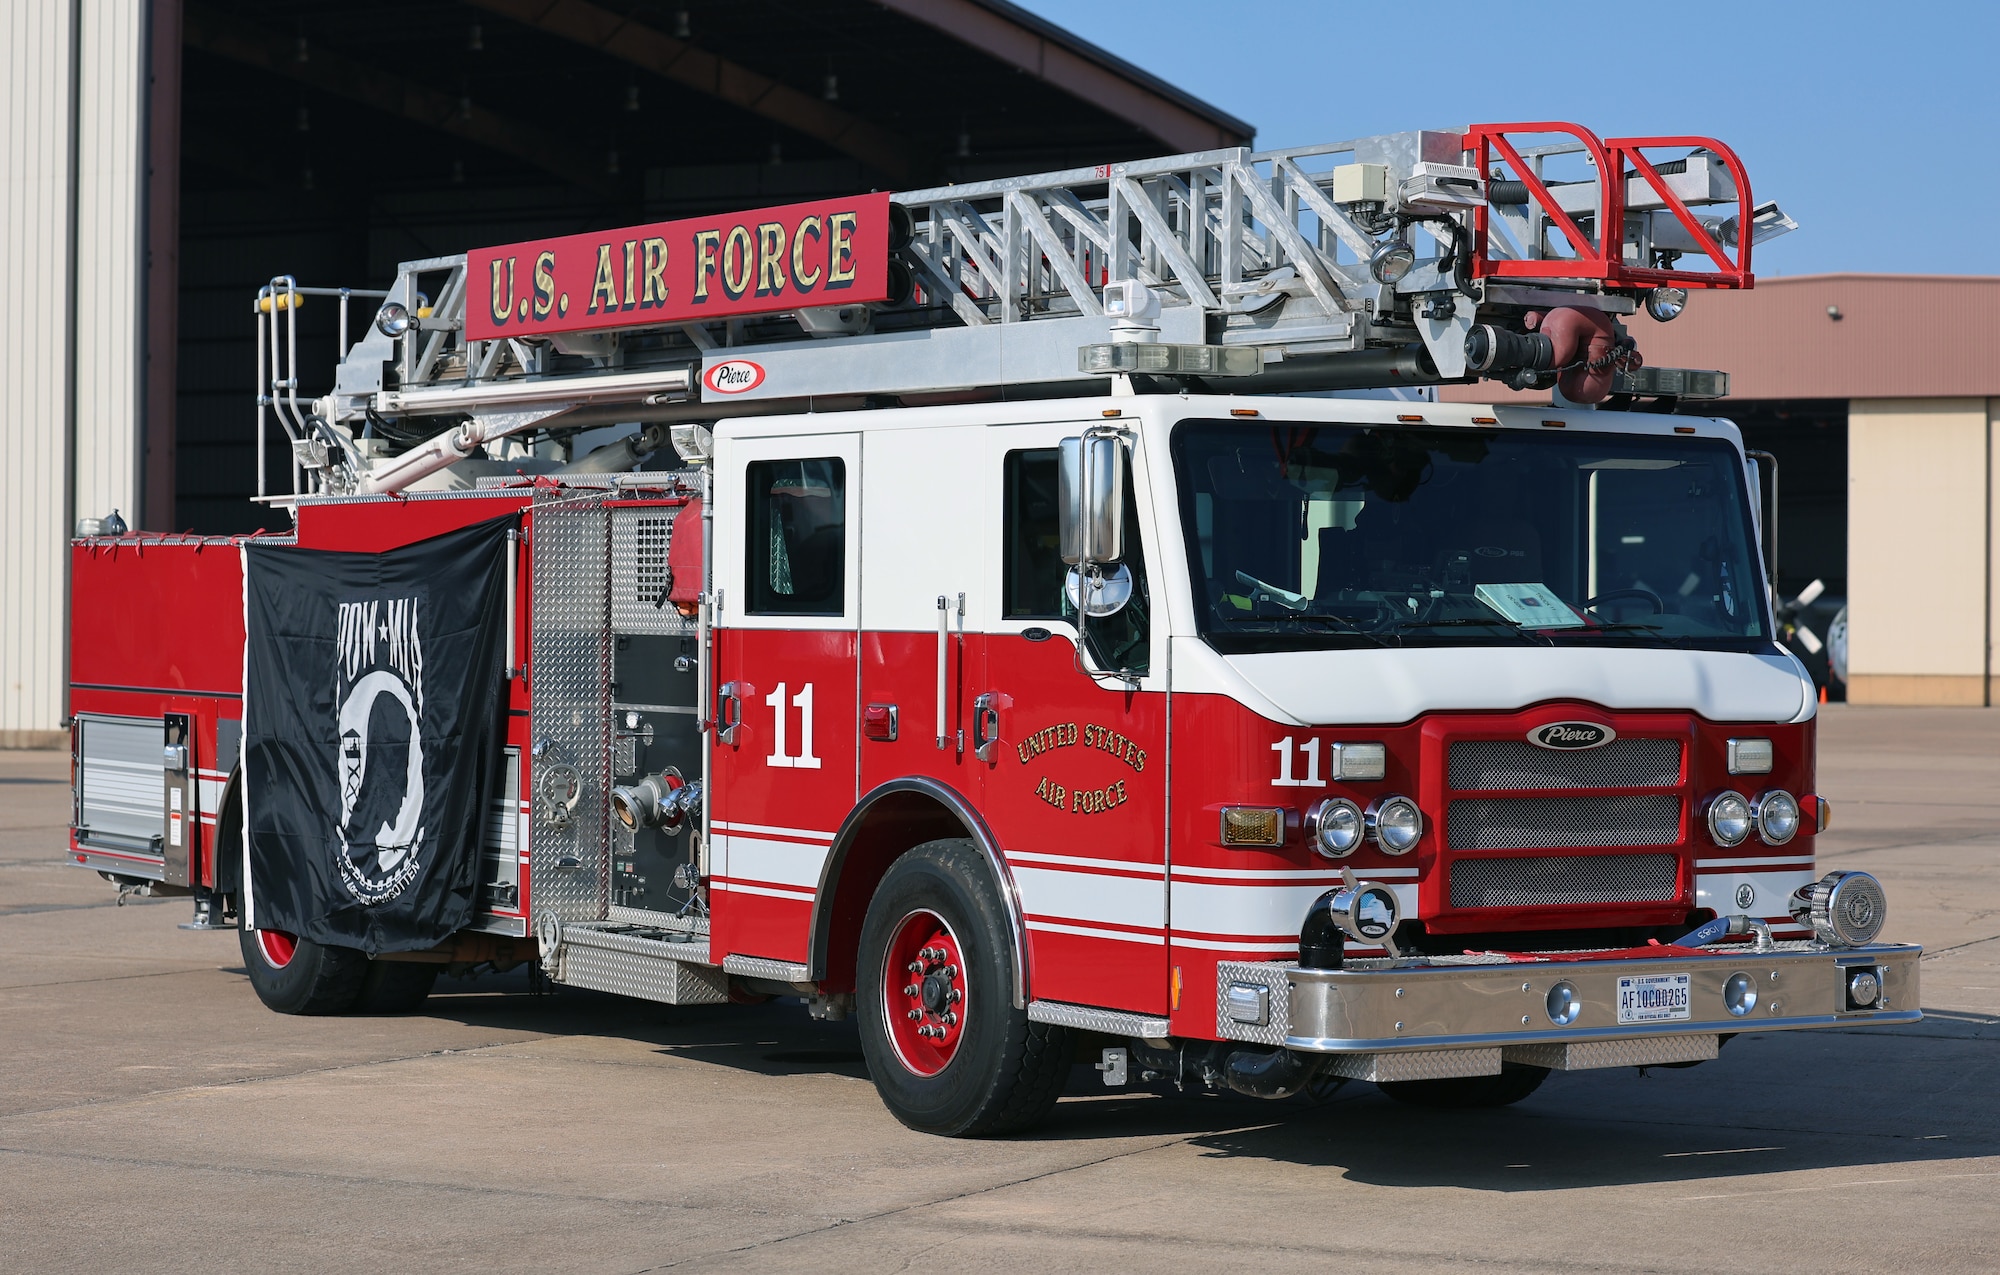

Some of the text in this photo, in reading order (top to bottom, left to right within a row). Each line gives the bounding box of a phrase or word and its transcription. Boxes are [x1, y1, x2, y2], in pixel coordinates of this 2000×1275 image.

[1095, 167, 1105, 178] 75
[490, 211, 858, 326] U.S. AIR FORCE
[717, 361, 751, 388] Pierce
[765, 682, 822, 769] 11
[1017, 722, 1147, 772] UNITED STATES
[1545, 726, 1597, 744] Pierce
[1271, 736, 1327, 787] 11
[1035, 776, 1128, 814] AIR FORCE
